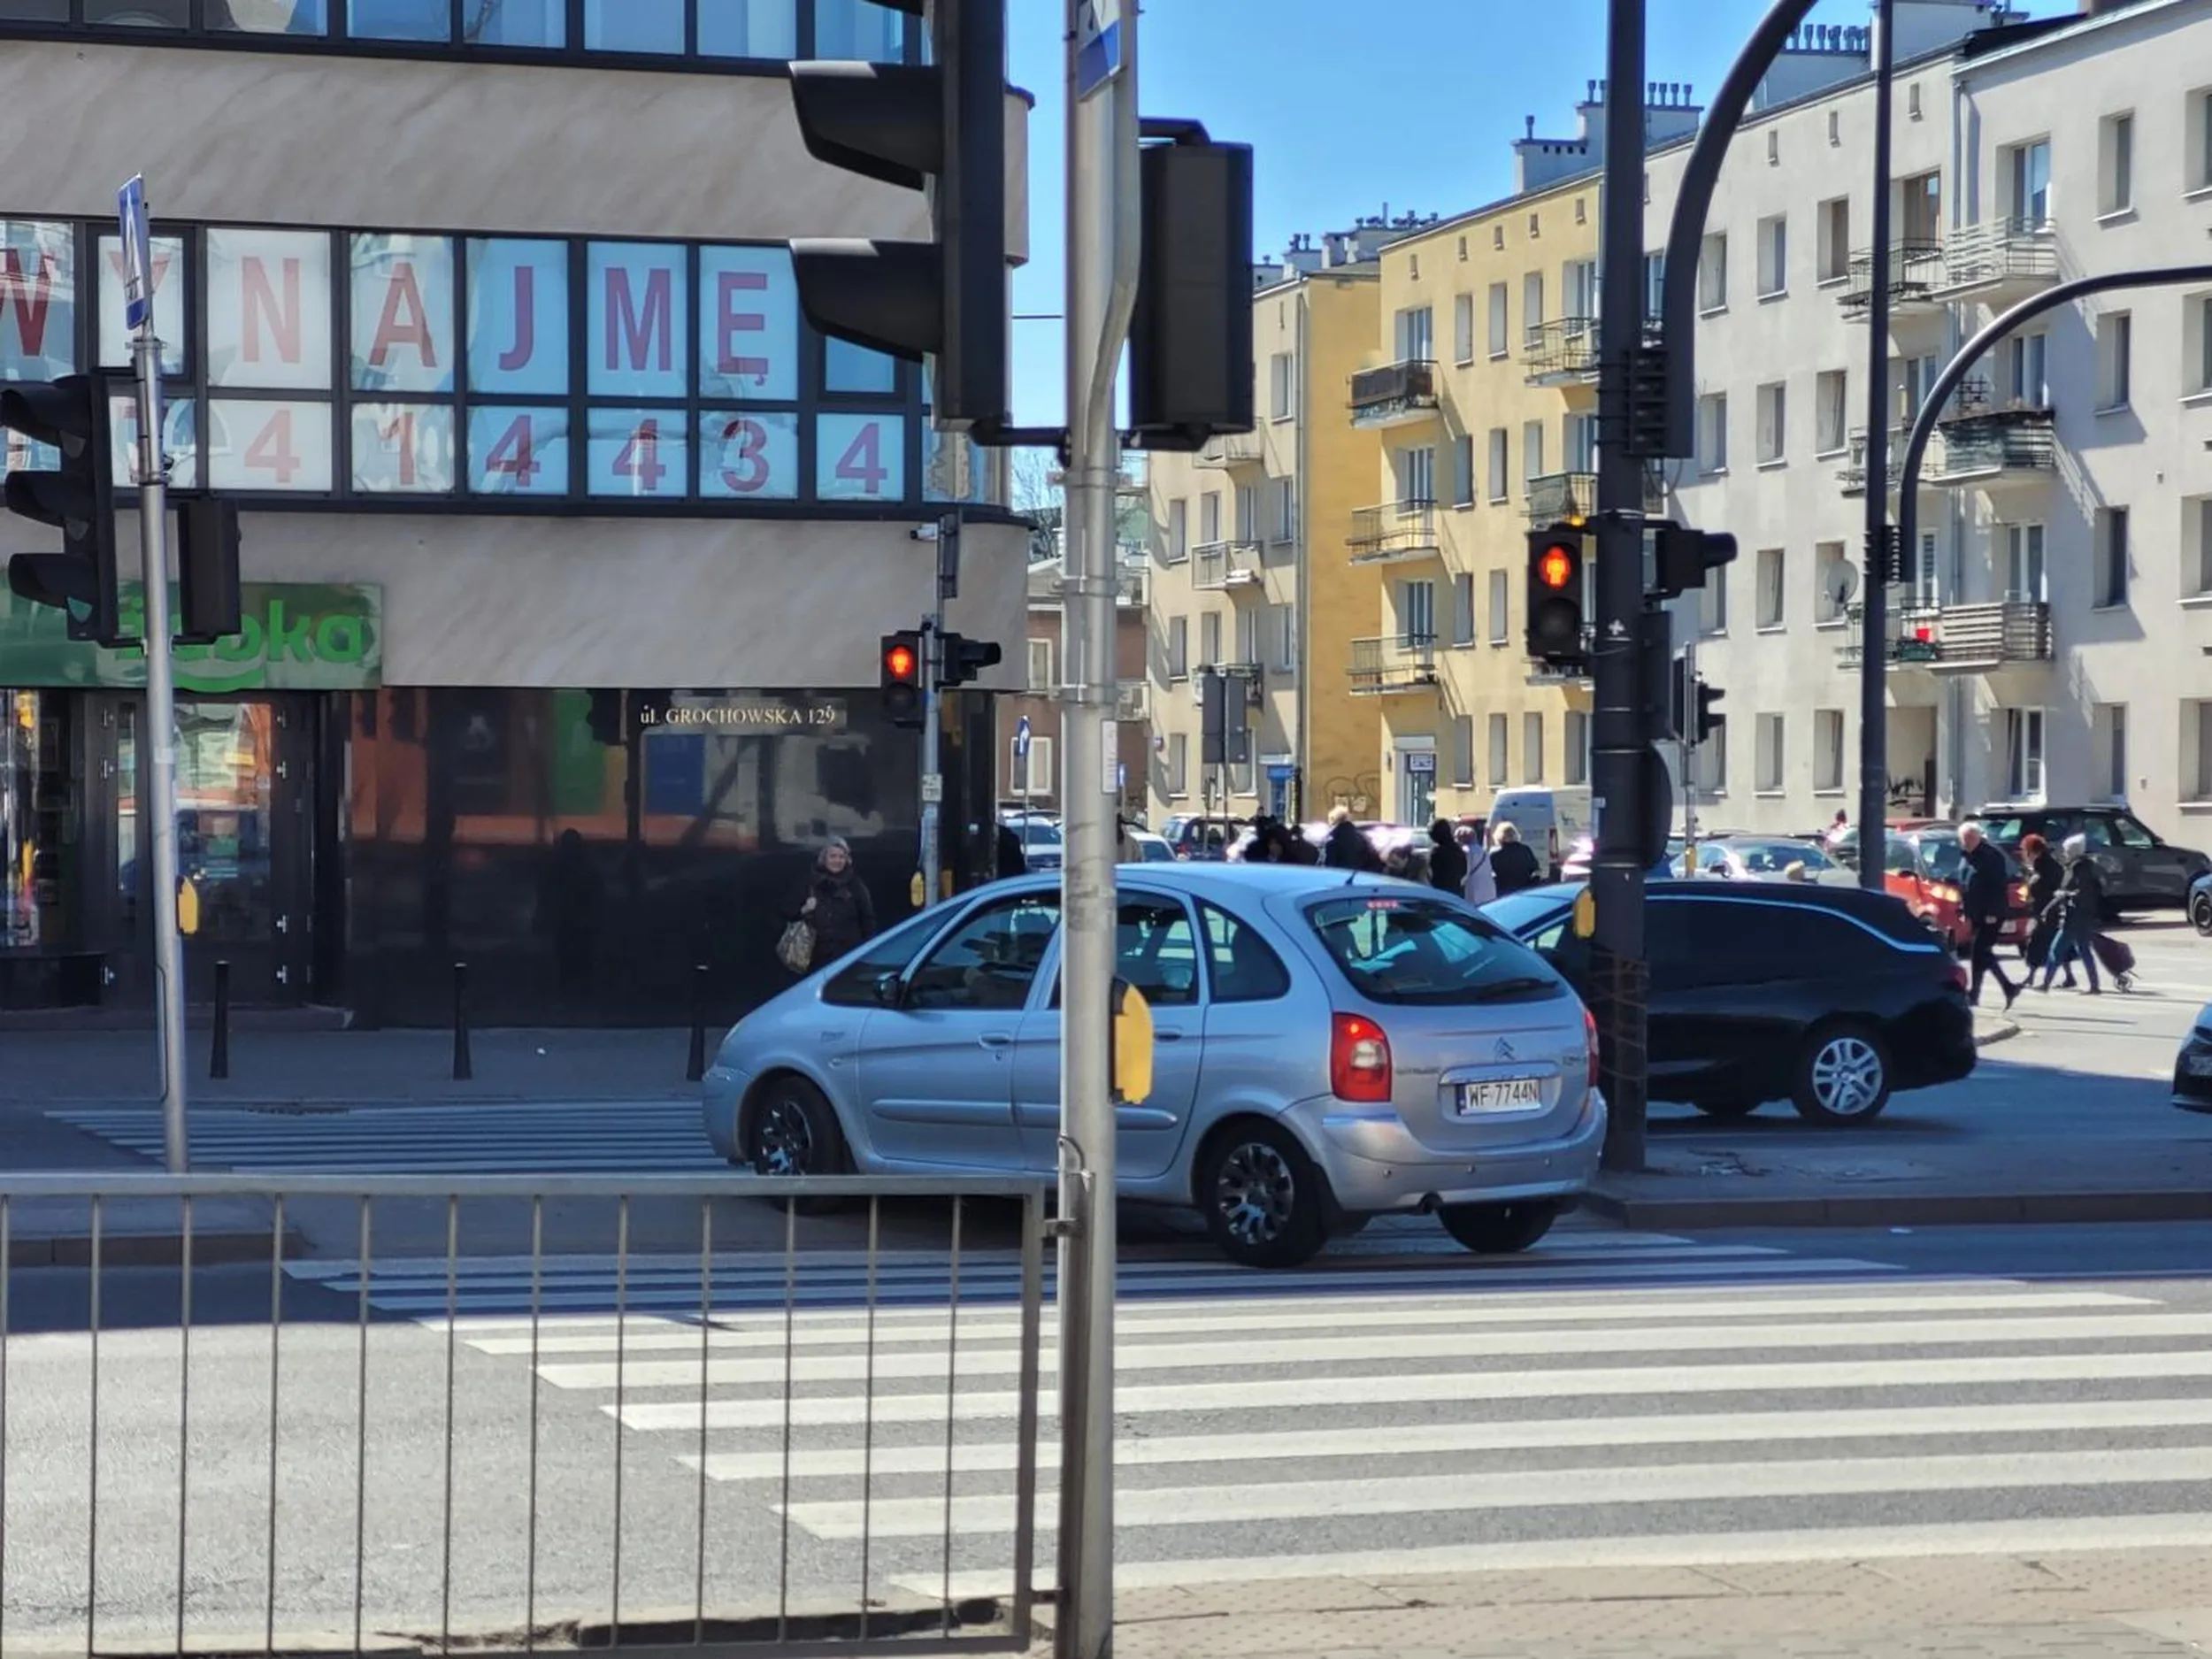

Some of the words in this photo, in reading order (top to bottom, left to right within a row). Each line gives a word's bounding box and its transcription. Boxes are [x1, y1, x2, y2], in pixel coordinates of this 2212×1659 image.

[124, 404, 887, 495] 414434
[665, 708, 802, 725] GROCHOWSKA
[808, 708, 835, 725] 129
[1469, 1084, 1489, 1107] WF
